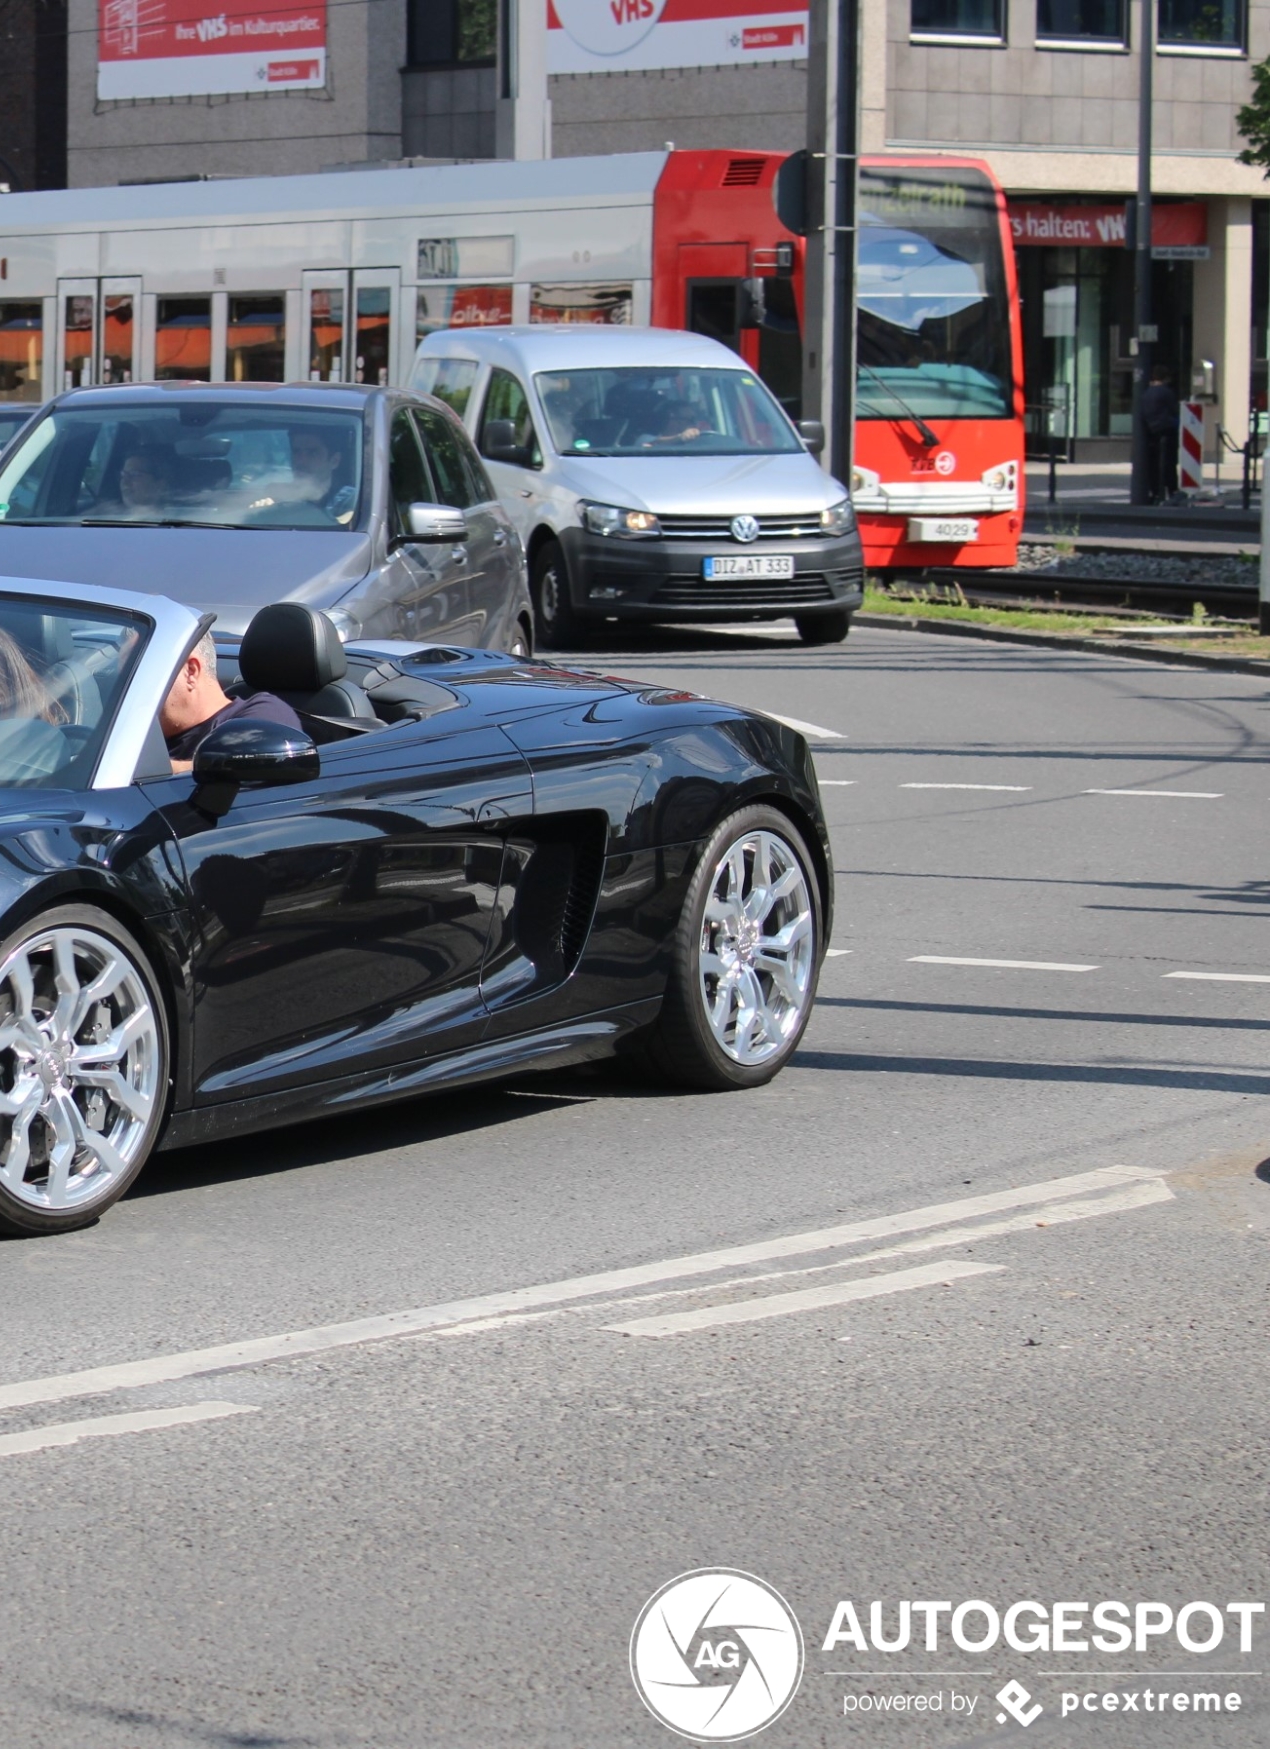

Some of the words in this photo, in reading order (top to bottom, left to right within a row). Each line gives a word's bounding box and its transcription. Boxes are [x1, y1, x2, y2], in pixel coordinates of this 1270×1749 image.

[176, 25, 196, 40] Ihre
[197, 14, 228, 42] VHS
[230, 22, 243, 36] im
[1027, 212, 1091, 238] halten:
[936, 524, 969, 536] 4029
[714, 559, 737, 574] DIZ
[747, 559, 762, 573] AT
[766, 558, 790, 573] 333
